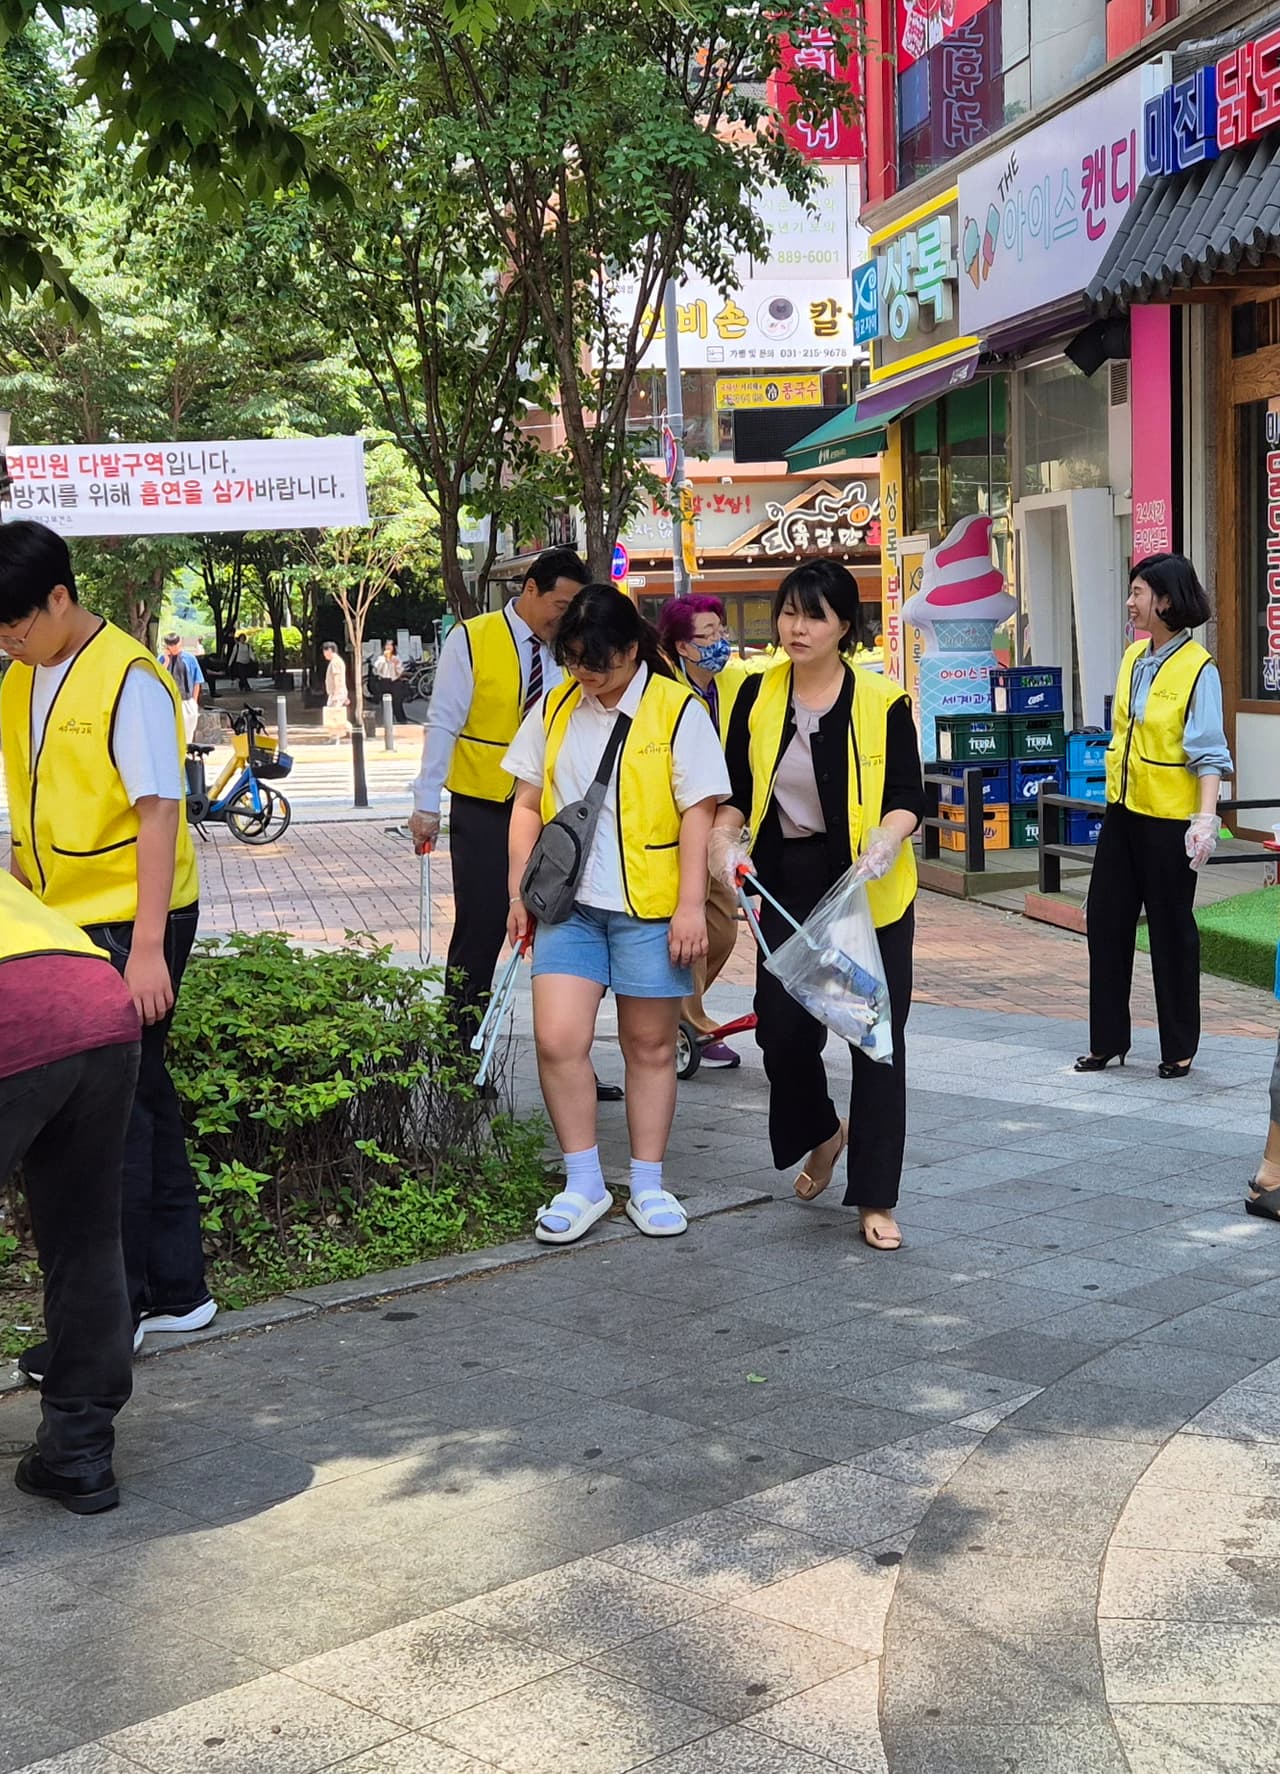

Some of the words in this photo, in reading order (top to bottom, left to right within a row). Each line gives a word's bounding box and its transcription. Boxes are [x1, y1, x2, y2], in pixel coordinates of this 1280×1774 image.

[1144, 66, 1210, 177] 미진
[997, 149, 1020, 203] THE
[882, 216, 954, 342] 상록
[782, 381, 818, 400] 콩국수
[8, 453, 70, 480] 연민원
[78, 450, 236, 478] 다발구역입니다.
[88, 482, 131, 507] 위해
[140, 479, 204, 506] 흡연을
[212, 474, 345, 504] 삼가바랍니다.
[1136, 499, 1166, 526] 24시간
[940, 668, 995, 680] 아이스크
